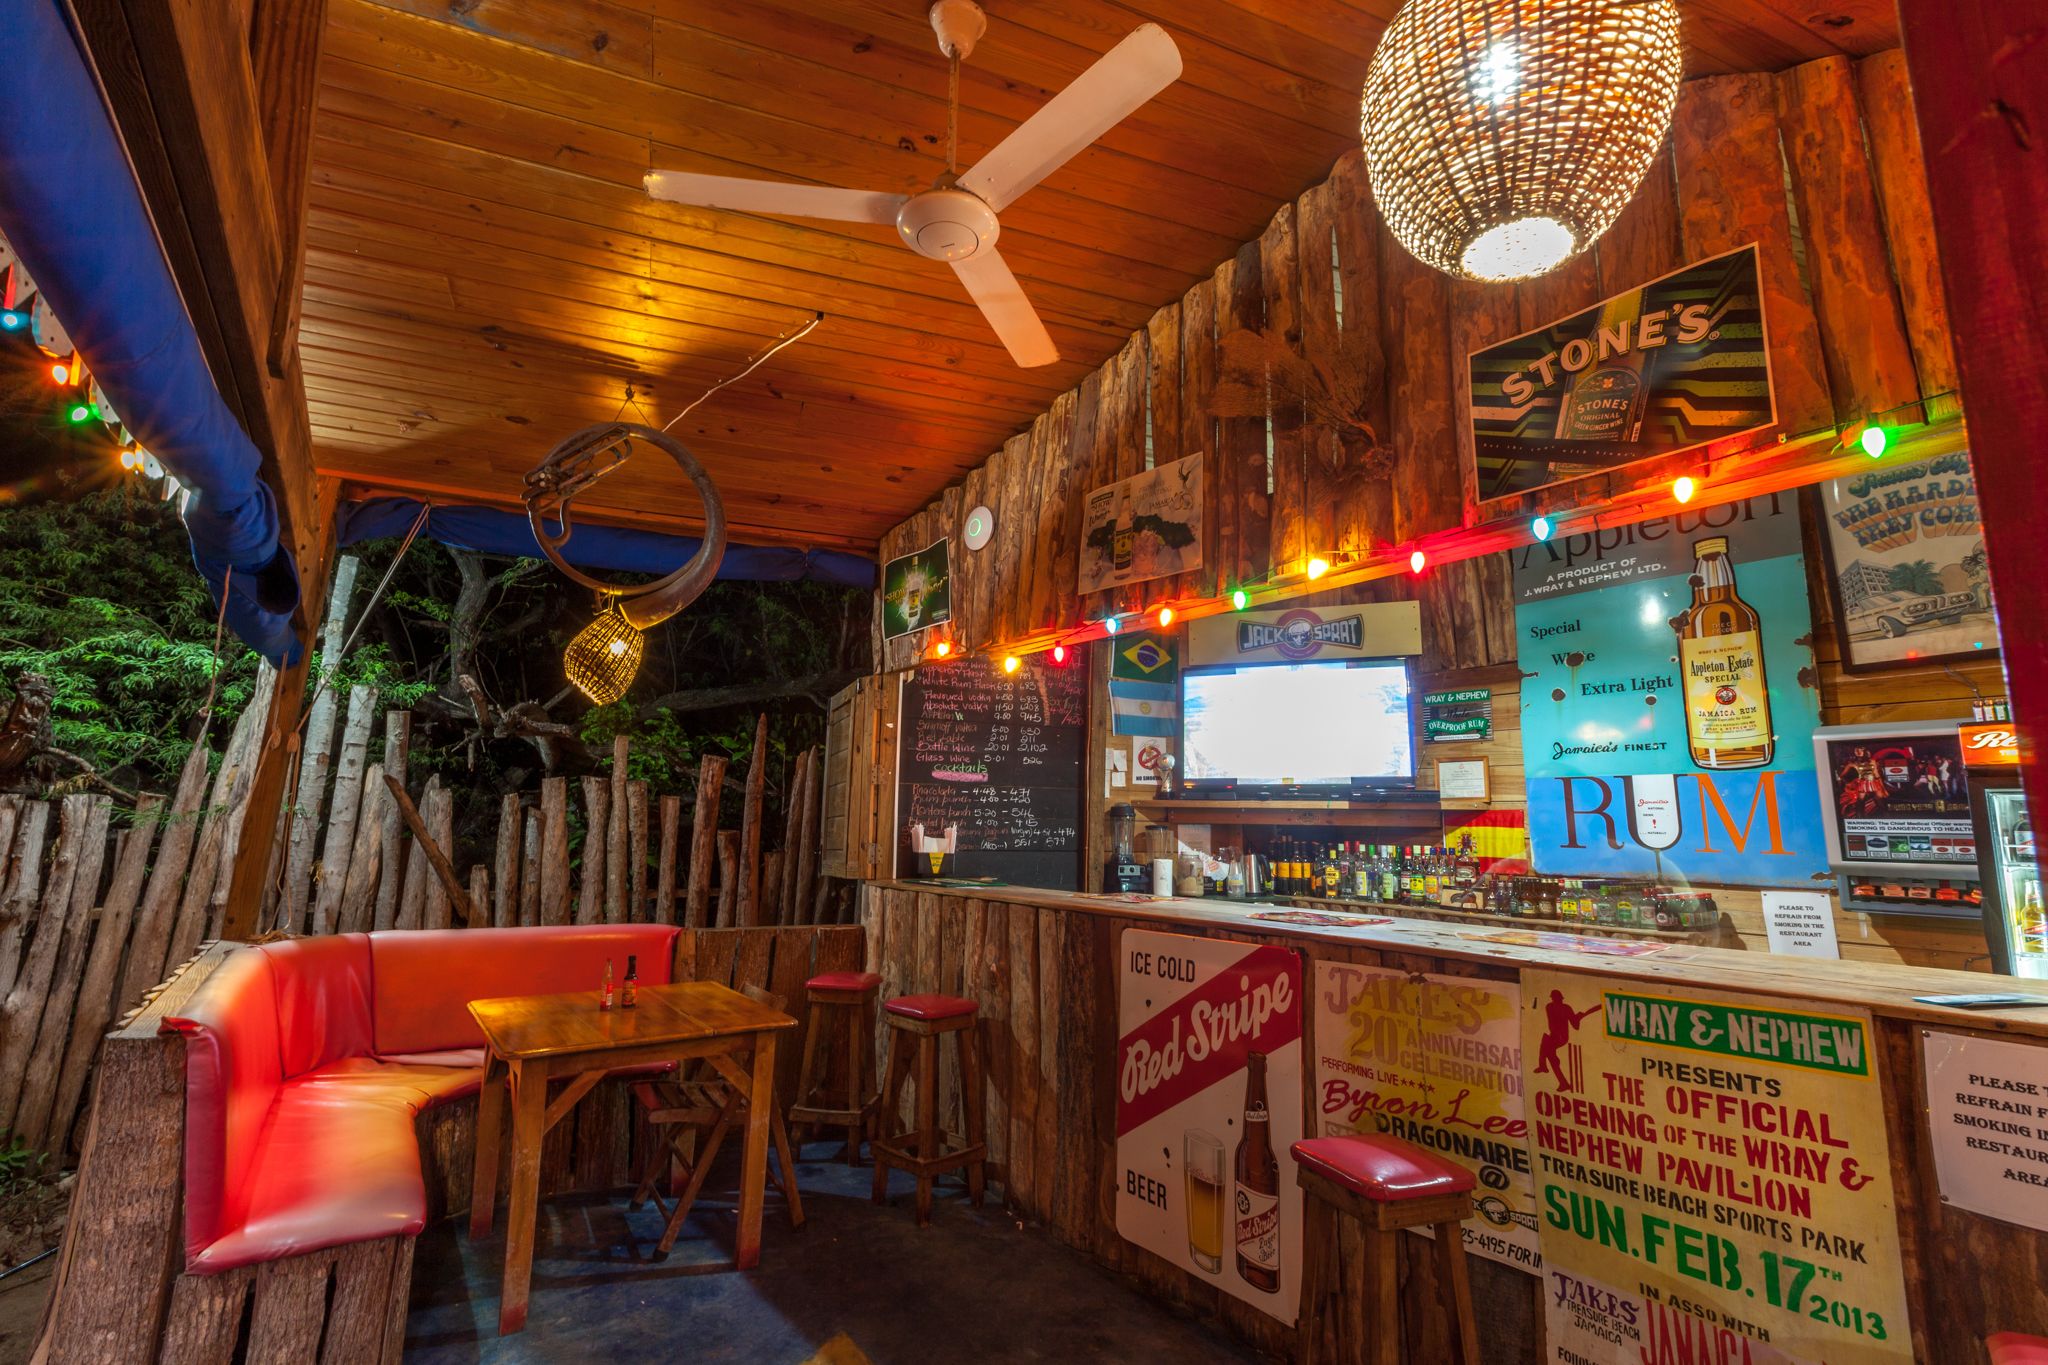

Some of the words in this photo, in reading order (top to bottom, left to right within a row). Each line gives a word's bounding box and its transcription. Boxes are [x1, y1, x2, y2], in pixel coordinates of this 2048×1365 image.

[1501, 302, 1711, 405] STONE'S
[1577, 398, 1628, 414] STONE'S
[1580, 411, 1620, 421] ORIGINAL
[1589, 423, 1610, 432] GINGER
[1884, 477, 1977, 510] HARD
[1919, 503, 1979, 527] COM
[1533, 583, 1564, 595] WRAY
[1567, 580, 1575, 588] &
[1579, 568, 1634, 586] NEPHEW
[1637, 563, 1667, 574] LTD.
[1546, 575, 1555, 583] A
[1557, 561, 1617, 581] PRODUCT
[1620, 557, 1637, 567] OF
[1243, 623, 1285, 649] JACK
[1313, 618, 1358, 644] SPRAT
[1530, 619, 1582, 640] Special
[1690, 659, 1725, 677] Appleton
[1727, 655, 1755, 673] Estate
[1704, 673, 1742, 683] SPECIAL
[1423, 693, 1446, 704] WRAY
[1447, 693, 1455, 702] &
[1456, 690, 1489, 701] NEPHEW
[1581, 682, 1627, 697] Extra
[1631, 674, 1674, 693] Light
[1020, 712, 1042, 723] 945
[1428, 720, 1467, 731] OVERPROOF
[1468, 719, 1484, 728] RUM
[1698, 709, 1736, 717] JAMAICA
[1739, 706, 1757, 715] RUM
[915, 751, 945, 762] Glass
[1022, 755, 1043, 765] 526
[916, 740, 948, 752] Bottle
[1552, 741, 1619, 760] Jamaica's
[1624, 742, 1668, 752] FINEST
[1009, 795, 1031, 804] 420
[1011, 807, 1035, 819] 546
[1015, 818, 1039, 827] 415
[1554, 771, 1796, 856] RUM
[1045, 837, 1066, 848] 579
[1130, 950, 1152, 977] ICE
[1157, 954, 1196, 984] COLD
[1324, 966, 1490, 1035] JAKES
[1121, 1015, 1185, 1104] Red
[1185, 971, 1294, 1063] Stripe
[1605, 996, 1679, 1042] WRAY
[1689, 1009, 1724, 1045] &
[1727, 1012, 1863, 1068] NEPHEW
[1406, 1030, 1522, 1070] ANNIVERSAR
[1321, 1056, 1374, 1081] PERFORMING
[1377, 1070, 1399, 1087] LIVE
[1641, 1056, 1782, 1098] PRESENTS
[1968, 1073, 2040, 1096] PLEASE
[1322, 1079, 1440, 1125] Byron
[1441, 1088, 1529, 1138] Lee
[1602, 1071, 1645, 1107] THE
[1666, 1085, 1850, 1149] OFFICIAL
[1955, 1092, 2032, 1116] REFRAIN
[1953, 1113, 2033, 1138] SMOKING
[1534, 1091, 1657, 1144] OPENING
[1663, 1123, 1687, 1145] OF
[1692, 1129, 1737, 1158] THE
[1742, 1134, 1831, 1185] WRAY
[1838, 1156, 1875, 1192] &
[1535, 1121, 1644, 1175] NEPHEW
[1965, 1136, 2048, 1164] RESTAUR
[1126, 1168, 1168, 1211] BEER
[1479, 1164, 1510, 1191] @
[1539, 1153, 1640, 1200] TREASURE
[1643, 1183, 1708, 1220] BEACH
[1714, 1202, 1793, 1244] SPORTS
[1801, 1226, 1868, 1265] PARK
[1236, 1220, 1252, 1240] Red
[1252, 1211, 1278, 1236] Stripe
[1507, 1241, 1531, 1266] FOR
[1552, 1270, 1640, 1326] JAKES
[1566, 1298, 1609, 1328] TREASURE
[1611, 1318, 1641, 1342] BEACH
[1640, 1281, 1660, 1300] IN
[1668, 1293, 1718, 1323] ASSO
[1720, 1312, 1771, 1344] WITH
[1808, 1294, 1888, 1341] 2013
[1574, 1314, 1623, 1347] JAMAICA
